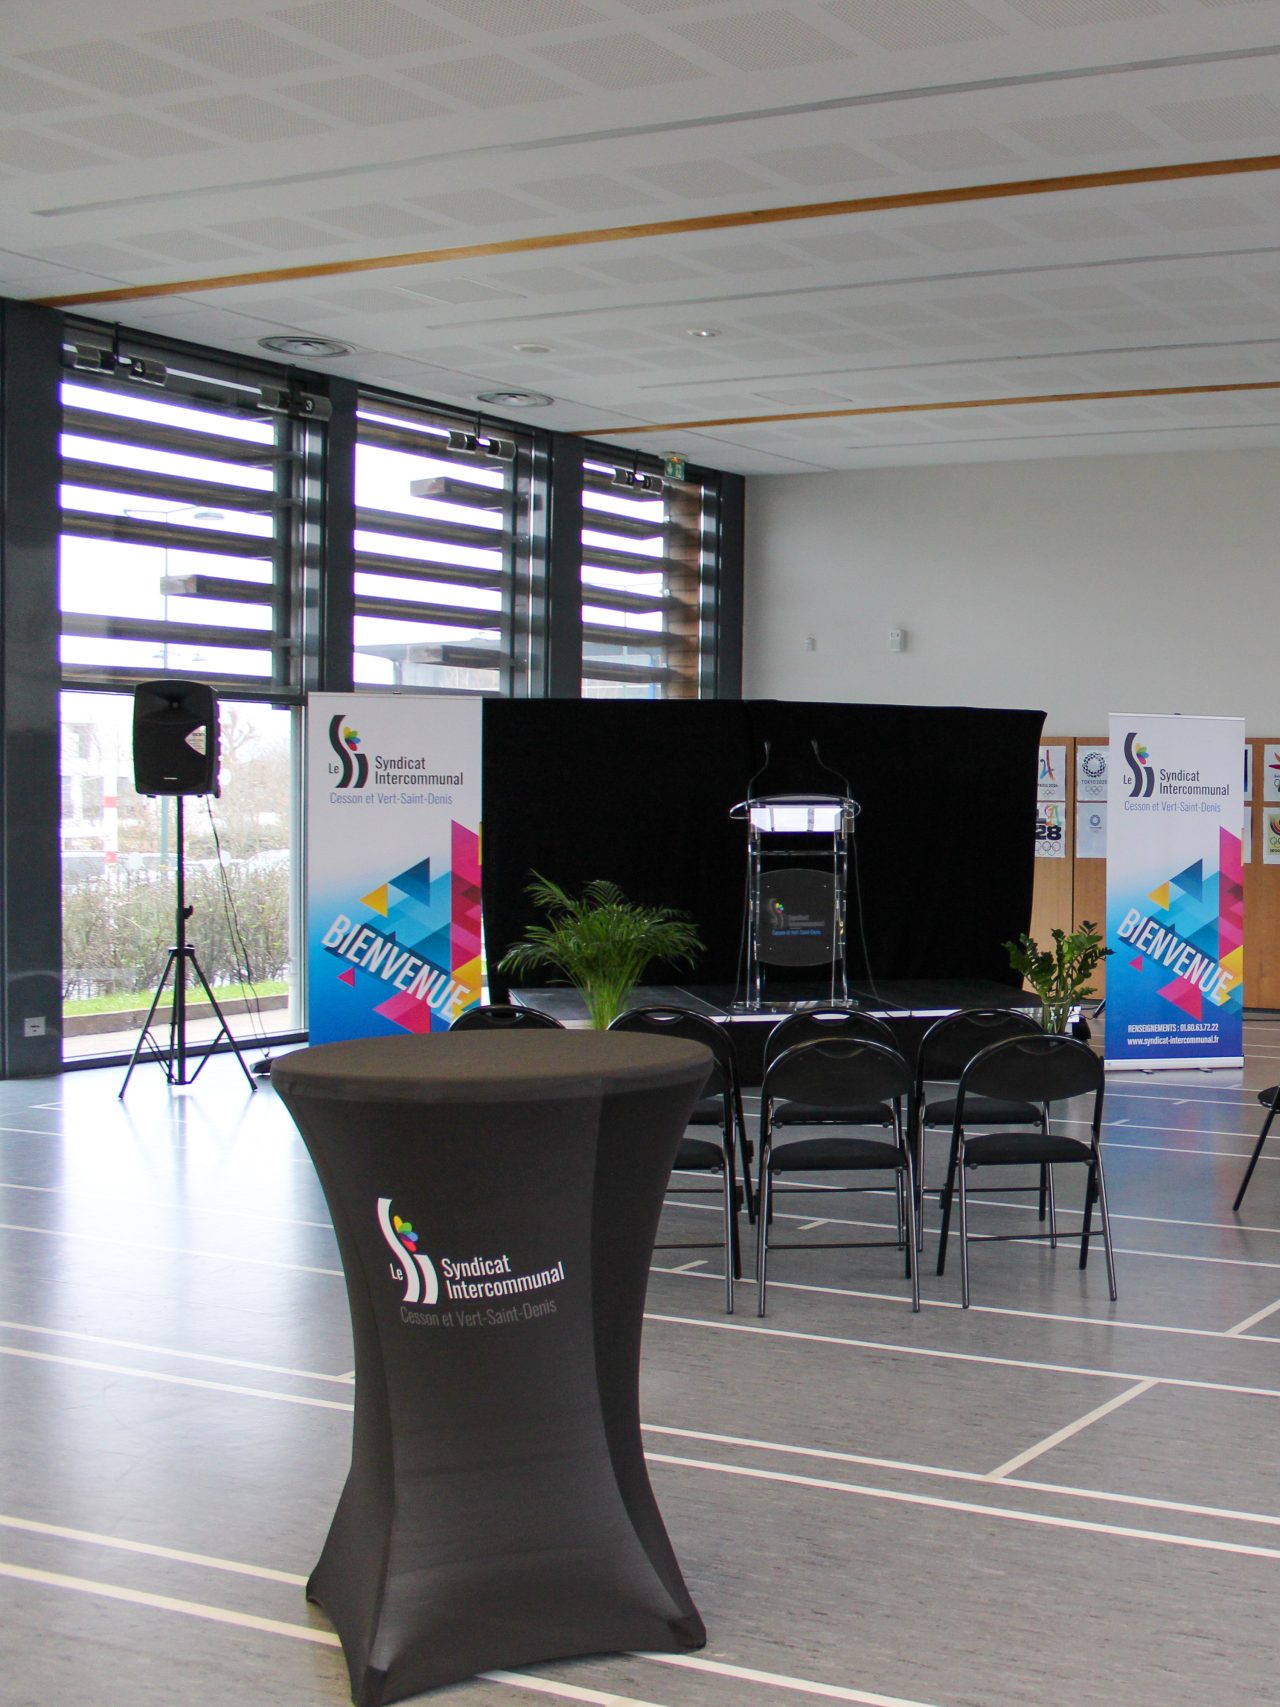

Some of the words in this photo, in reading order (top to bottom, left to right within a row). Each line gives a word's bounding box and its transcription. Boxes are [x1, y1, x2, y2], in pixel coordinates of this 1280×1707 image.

[304, 399, 313, 411] 3
[328, 762, 340, 774] Le
[375, 755, 426, 773] Syndicat
[375, 771, 464, 786] Intercommunal
[1123, 774, 1132, 785] Le
[1159, 768, 1201, 783] Syndicat
[1159, 782, 1230, 796] Intercommunal
[329, 791, 363, 805] Cesson
[365, 793, 375, 805] et
[377, 792, 454, 805] Vert-Saint-Denis
[1124, 800, 1151, 811] Cesson
[1152, 801, 1159, 811] et
[1161, 801, 1221, 813] Vert-Saint-Denis
[1036, 825, 1062, 841] 28
[1116, 907, 1234, 1003] BIENVENUE
[320, 913, 471, 1018] BIENVENUE
[1127, 1023, 1177, 1033] RENSEIGNEMENTS
[1127, 1035, 1220, 1047] www.syndicat-intercommunal.fr
[389, 1262, 404, 1281] Le
[441, 1254, 512, 1281] Syndicat
[446, 1260, 566, 1299] Intercommunal
[400, 1305, 440, 1327] Cesson
[442, 1312, 454, 1327] et
[456, 1299, 558, 1328] Vert-Saint-Denis
